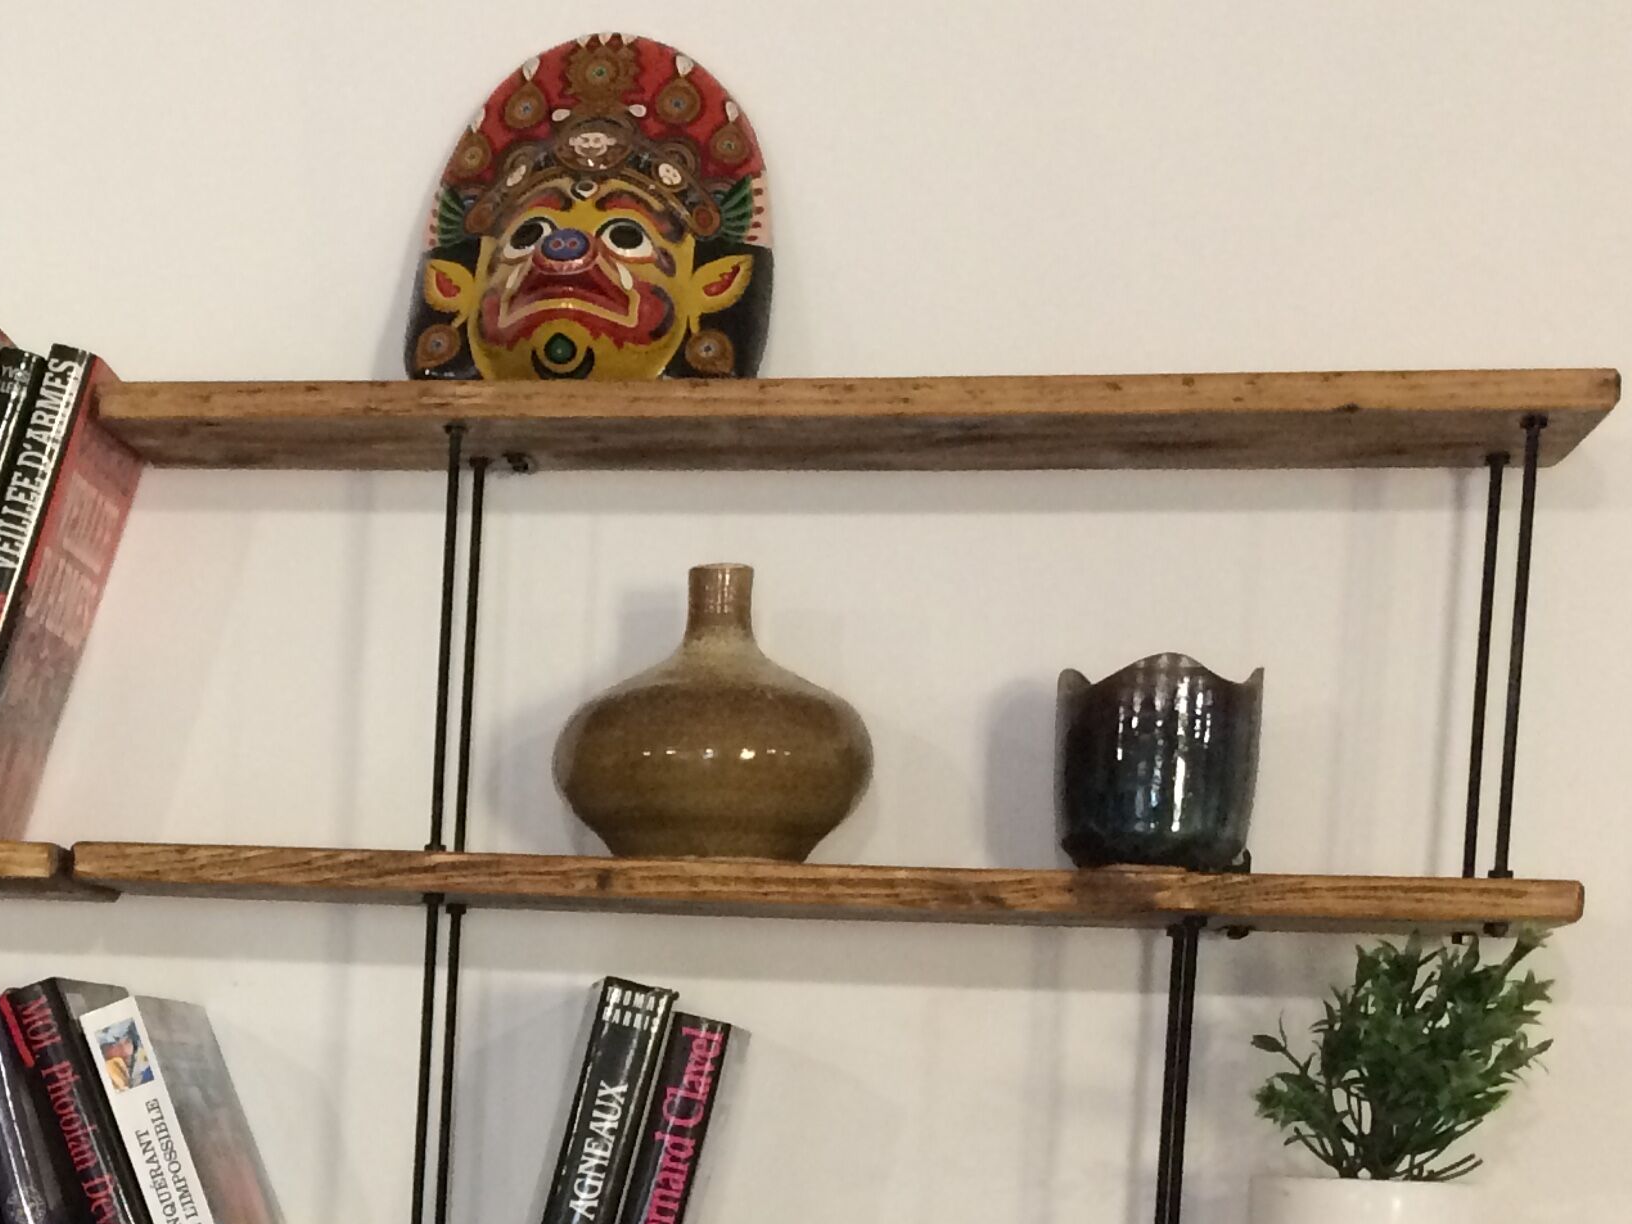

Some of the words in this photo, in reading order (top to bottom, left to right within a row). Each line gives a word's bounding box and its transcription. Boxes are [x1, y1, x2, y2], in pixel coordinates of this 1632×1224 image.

[18, 354, 81, 472] D'ARMES
[41, 1059, 104, 1171] Phoolan
[662, 1025, 724, 1129] Clavel
[145, 1098, 199, 1220] L'IMPOSSIBLE
[568, 1080, 629, 1221] AGNEAUX
